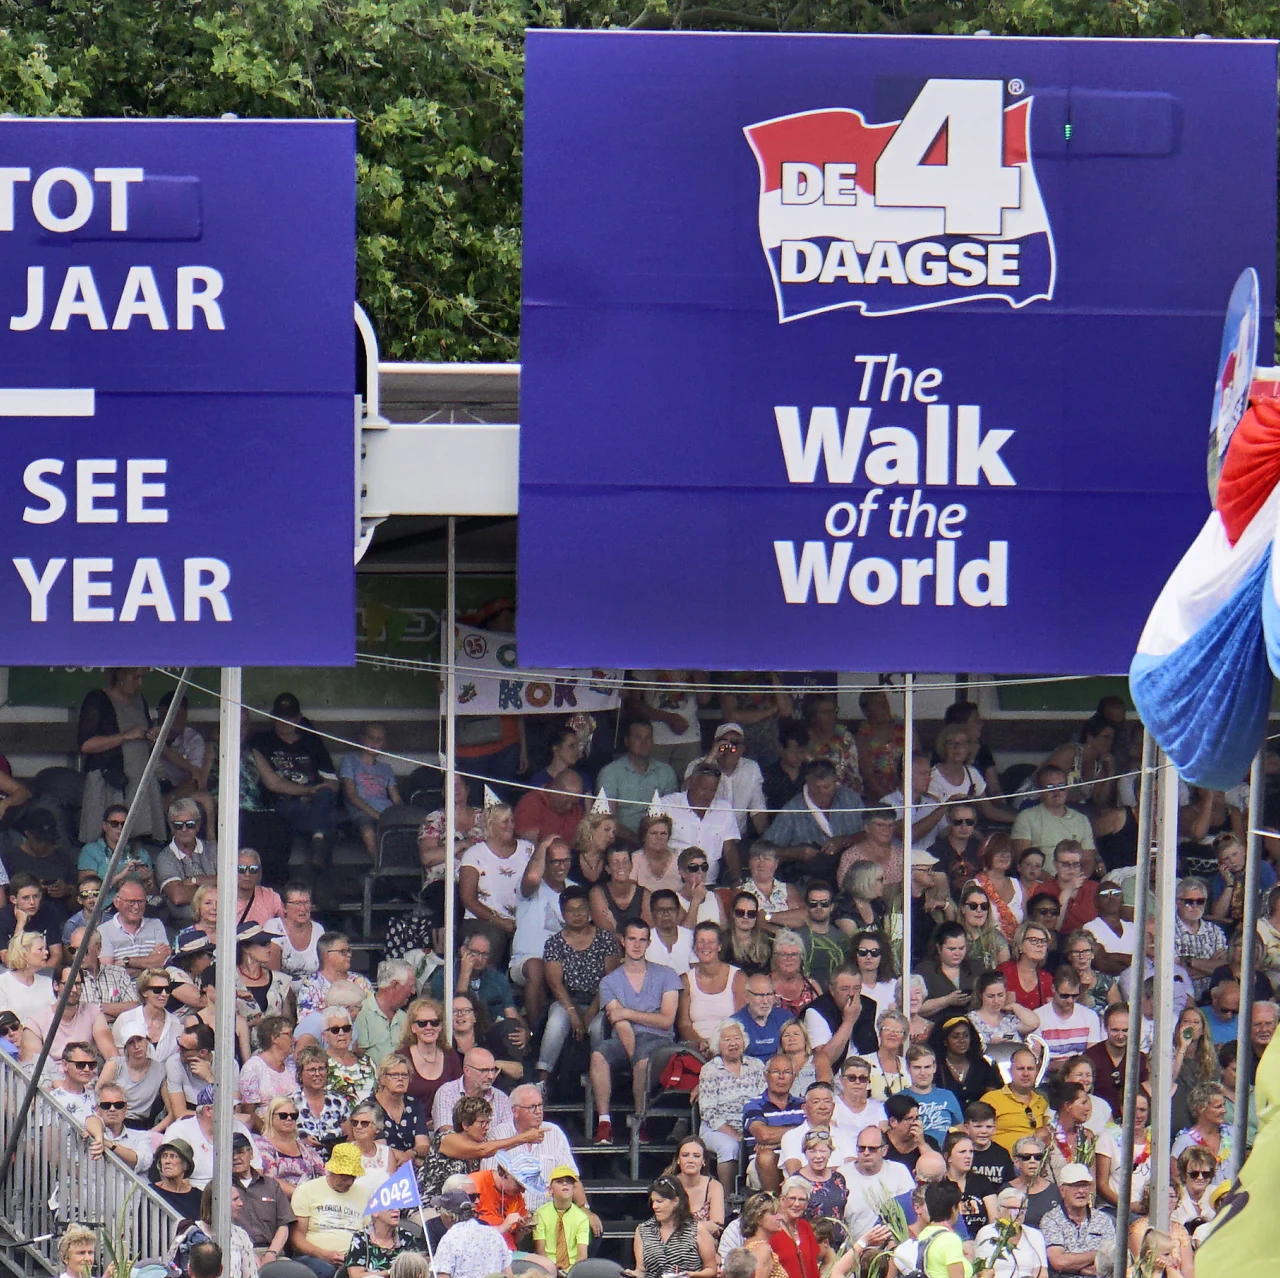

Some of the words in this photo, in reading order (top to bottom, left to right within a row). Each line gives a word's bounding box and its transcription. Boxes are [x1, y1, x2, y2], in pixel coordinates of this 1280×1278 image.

[781, 162, 858, 208] DE
[874, 78, 1021, 236] 4
[780, 239, 1021, 288] DAAGSE
[9, 265, 226, 332] JAAR
[853, 354, 943, 403] The
[774, 404, 1017, 487] Walk
[22, 457, 169, 525] SEE
[825, 490, 883, 538] of
[888, 490, 968, 540] the
[12, 557, 233, 623] YEAR
[774, 540, 1009, 607] World
[380, 1178, 412, 1207] 042
